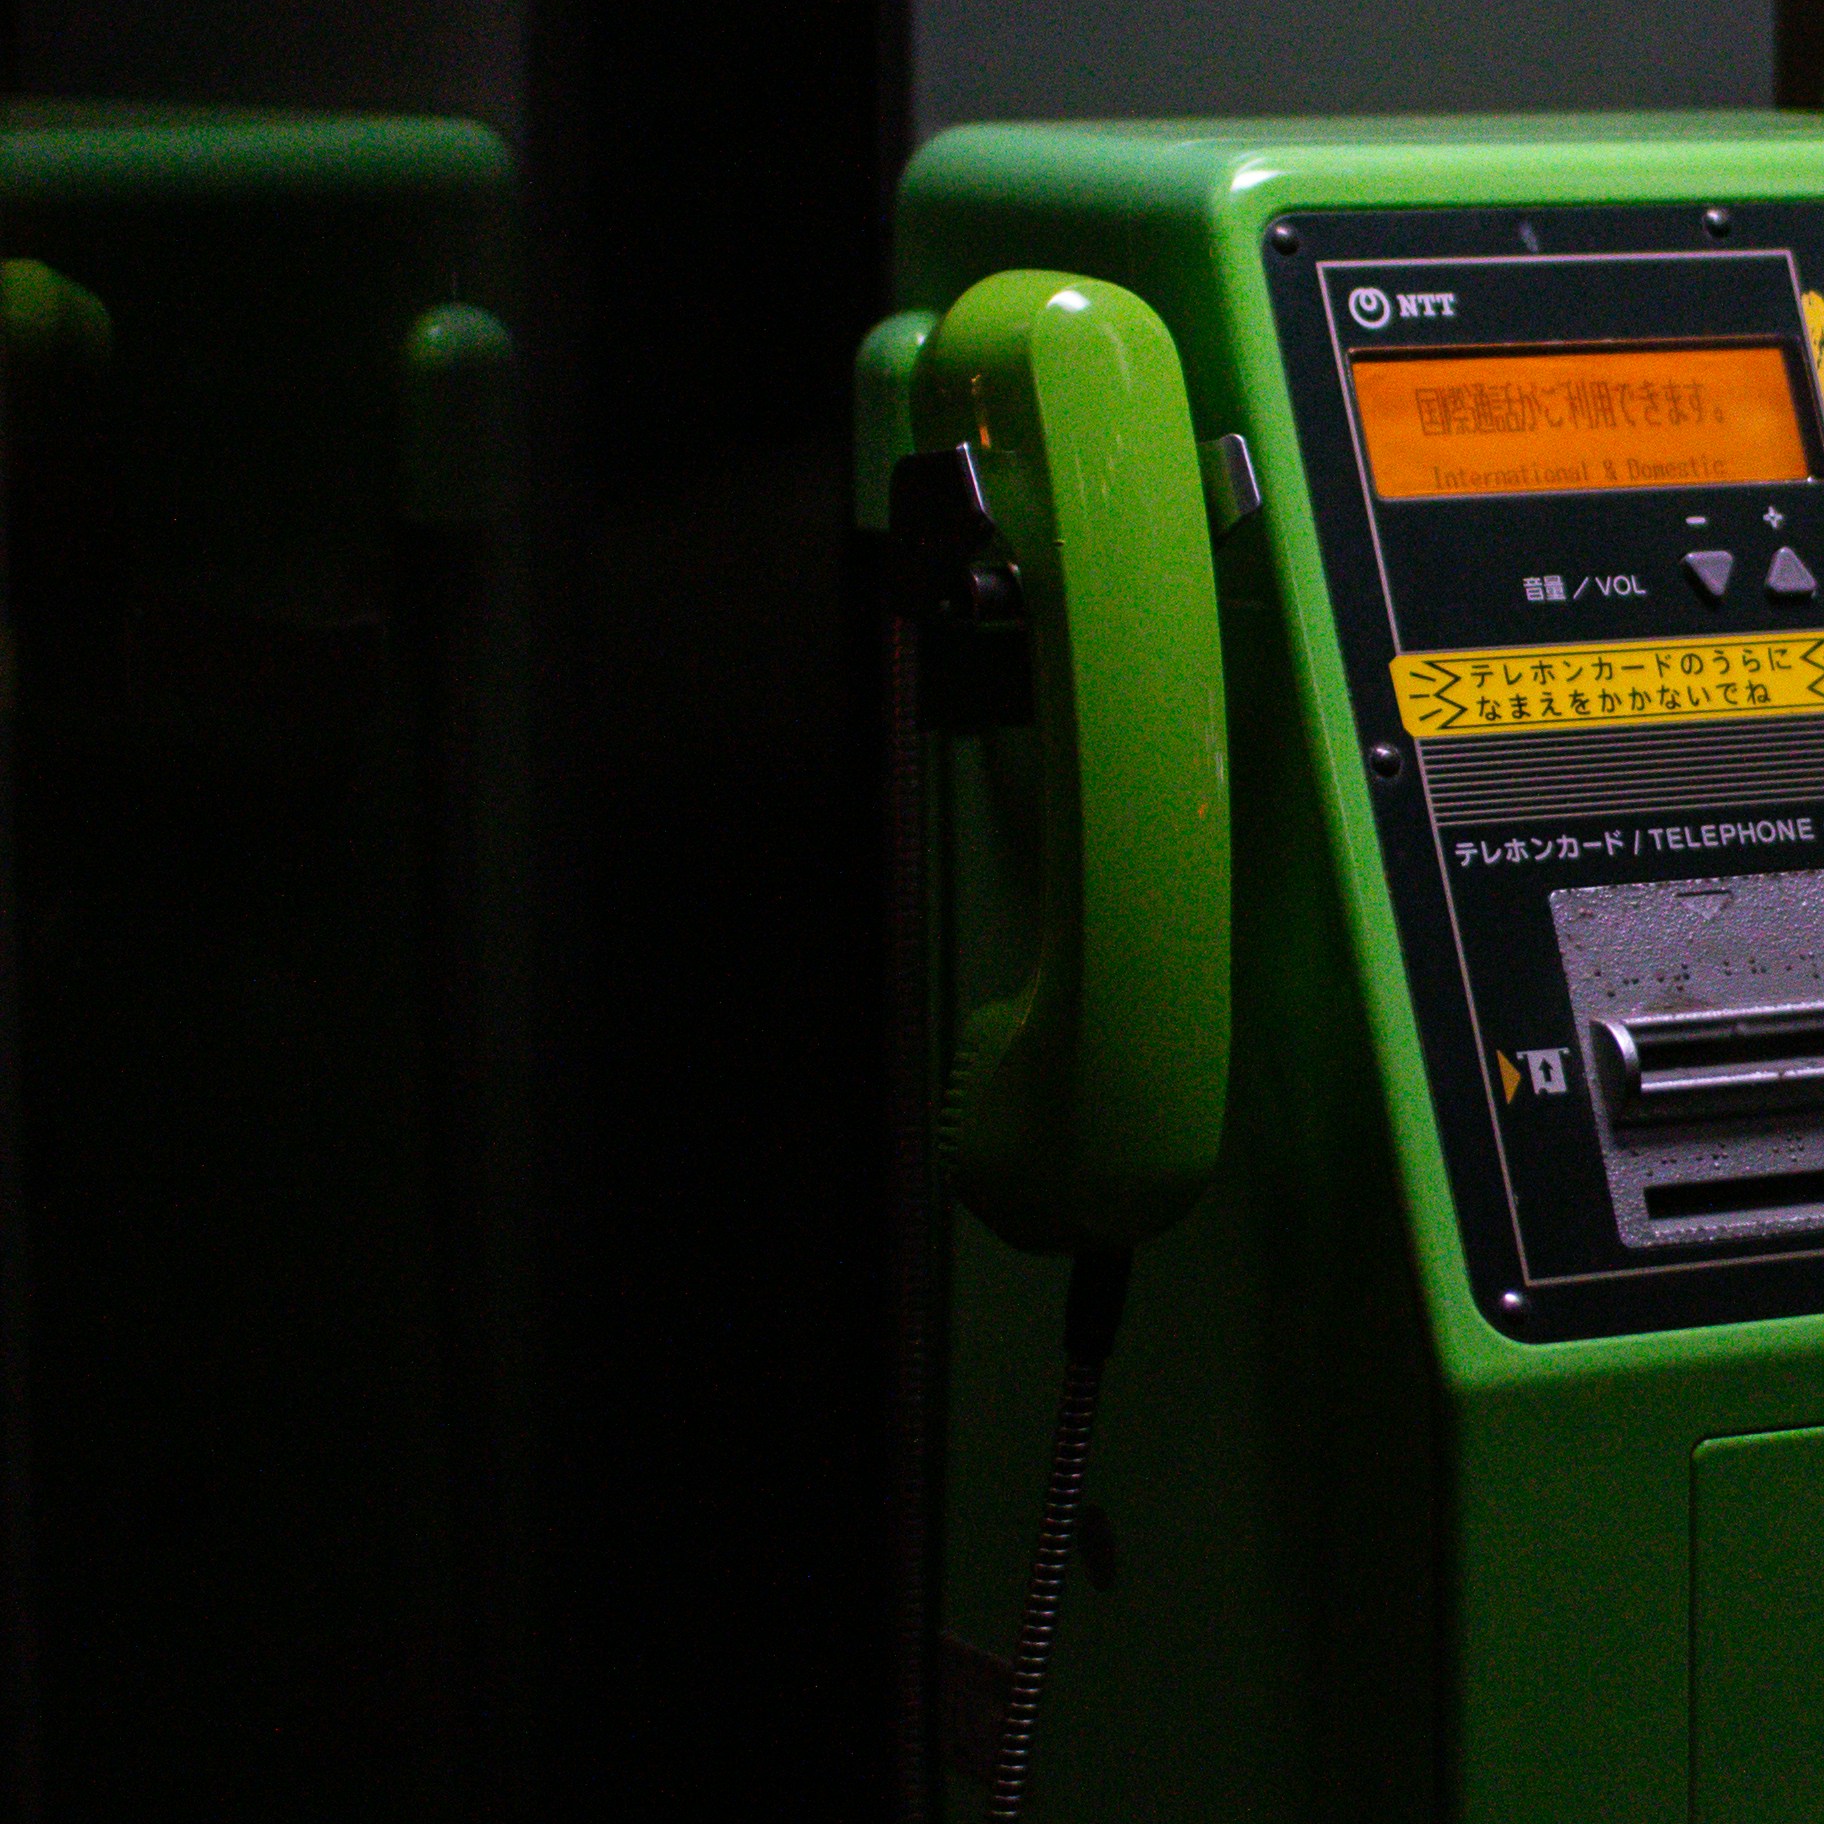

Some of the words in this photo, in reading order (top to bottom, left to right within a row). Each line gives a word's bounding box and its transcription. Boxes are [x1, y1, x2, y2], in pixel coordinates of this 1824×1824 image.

[1397, 292, 1458, 319] NTT
[1433, 461, 1590, 491] International
[1627, 456, 1727, 480] Domestic
[1470, 645, 1793, 688] テレホンカードのうらに
[1475, 678, 1773, 723] なまえをかかないでね
[1649, 818, 1815, 850] TELEPHONE
